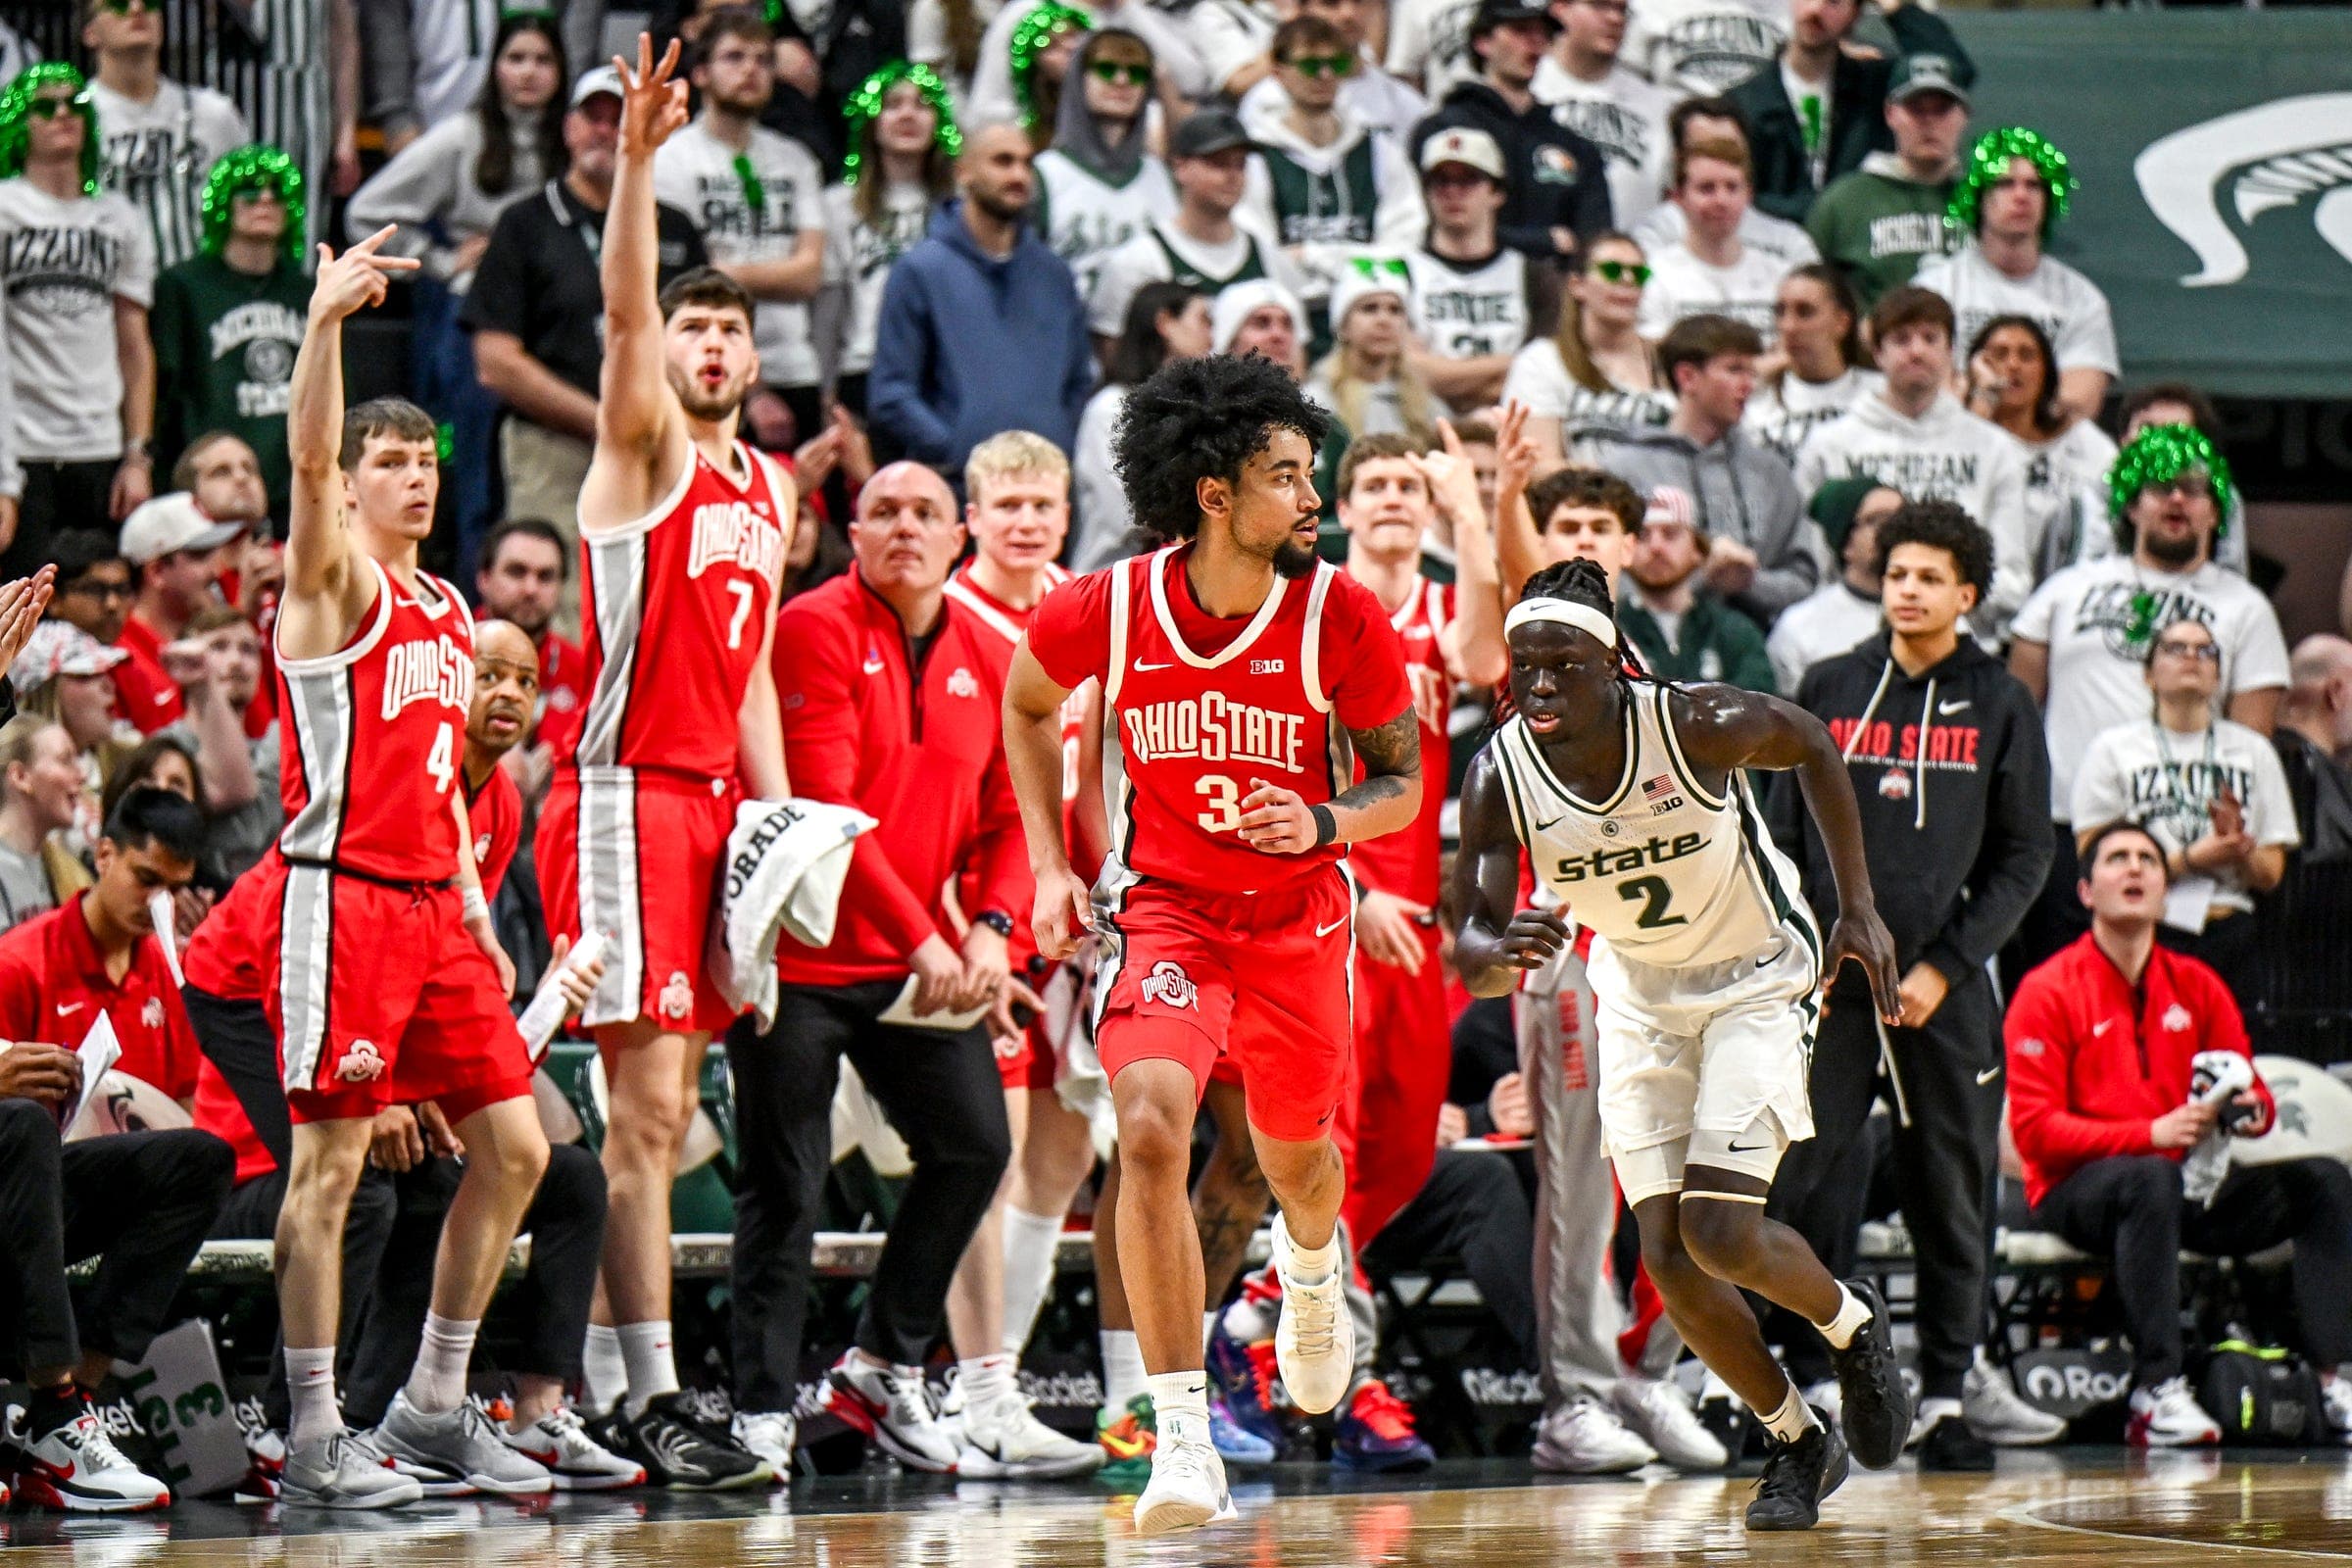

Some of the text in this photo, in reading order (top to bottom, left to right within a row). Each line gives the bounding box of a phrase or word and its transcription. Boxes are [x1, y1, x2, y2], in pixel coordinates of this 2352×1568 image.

[726, 578, 754, 650] 7
[426, 721, 455, 794] 4
[1899, 722, 1981, 764] SATE
[1195, 774, 1241, 833] 3
[727, 804, 806, 899] ORADE
[1616, 874, 1689, 929] 2
